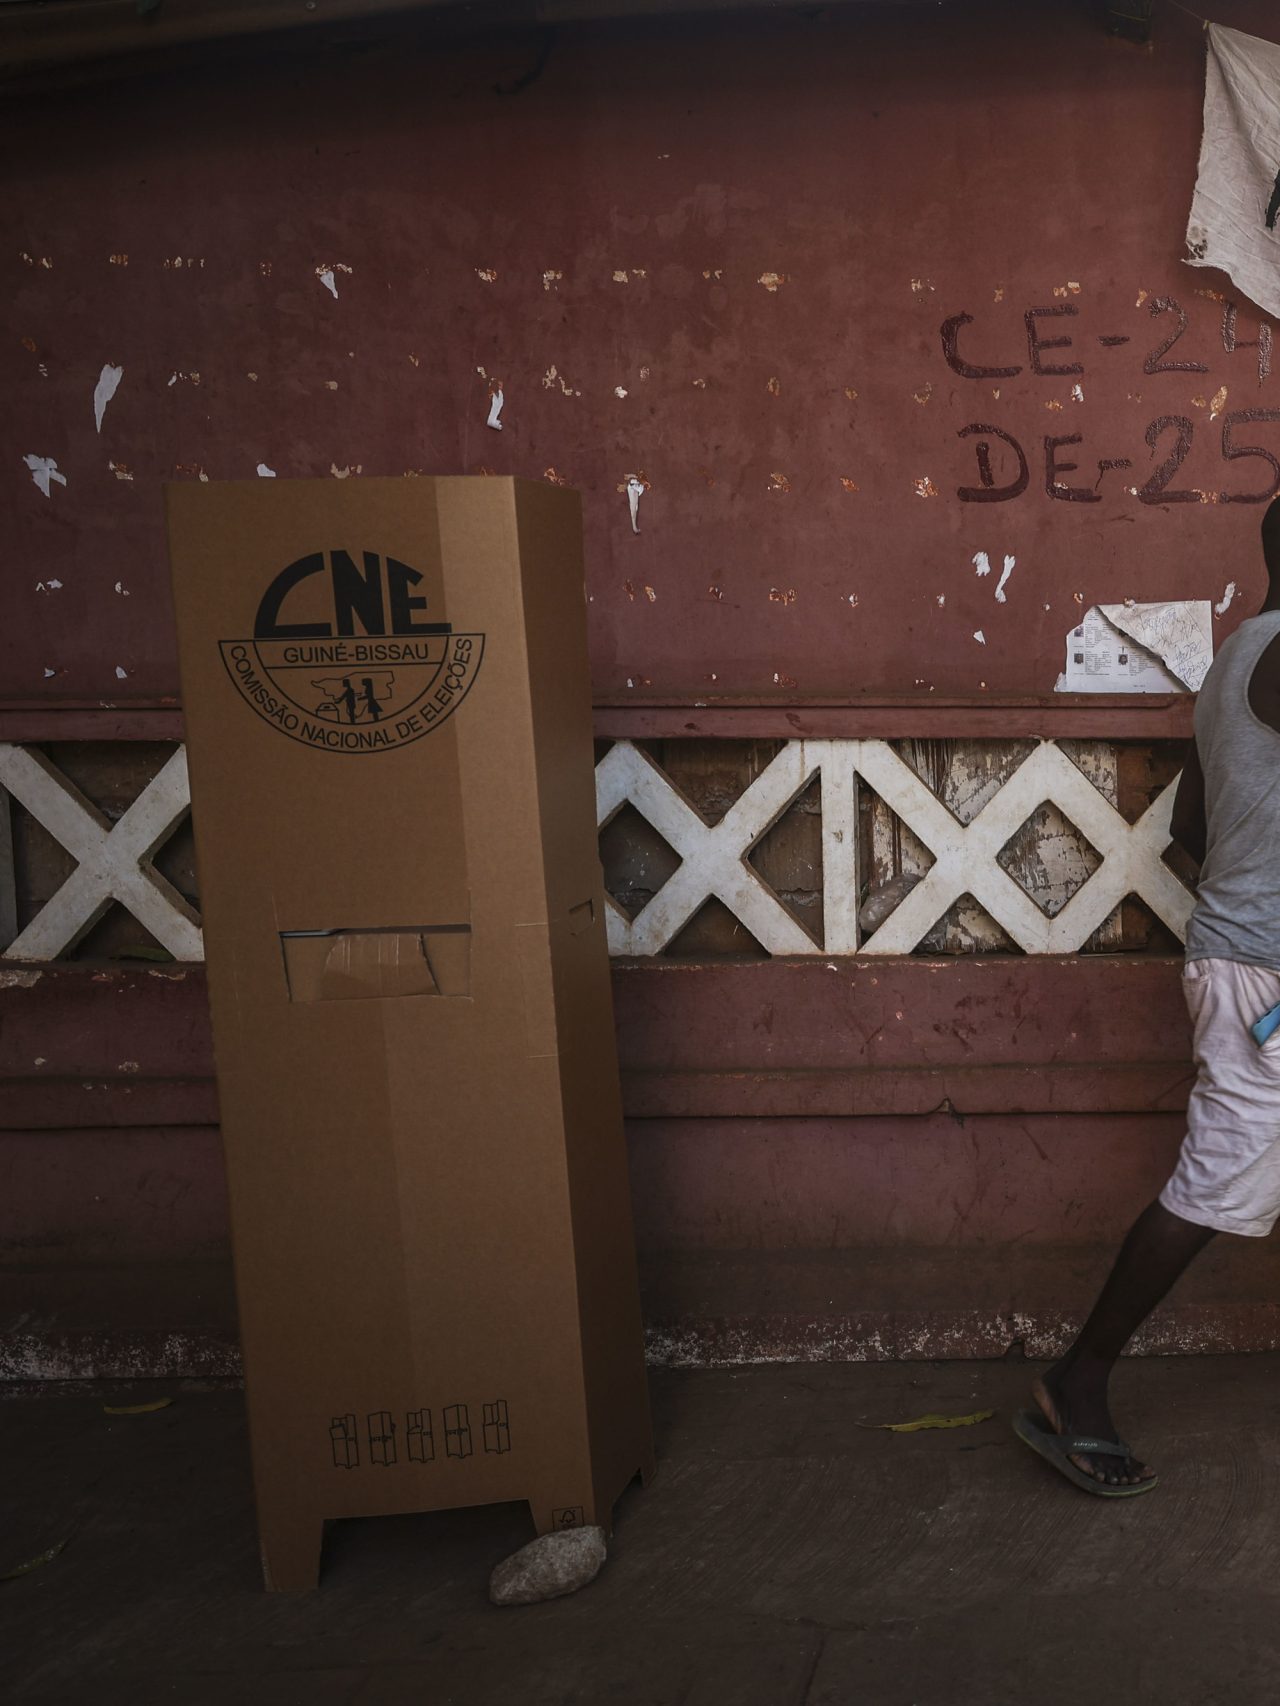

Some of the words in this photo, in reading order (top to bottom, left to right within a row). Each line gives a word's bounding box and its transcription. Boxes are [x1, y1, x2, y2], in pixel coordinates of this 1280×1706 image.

[253, 549, 452, 638] CNE
[230, 644, 298, 732] COMISSÃO
[300, 720, 396, 749] NACIONAL
[396, 717, 424, 740] DE
[420, 637, 473, 728] ELEIÇÕES
[283, 641, 430, 664] GUINÉ-BISSAU
